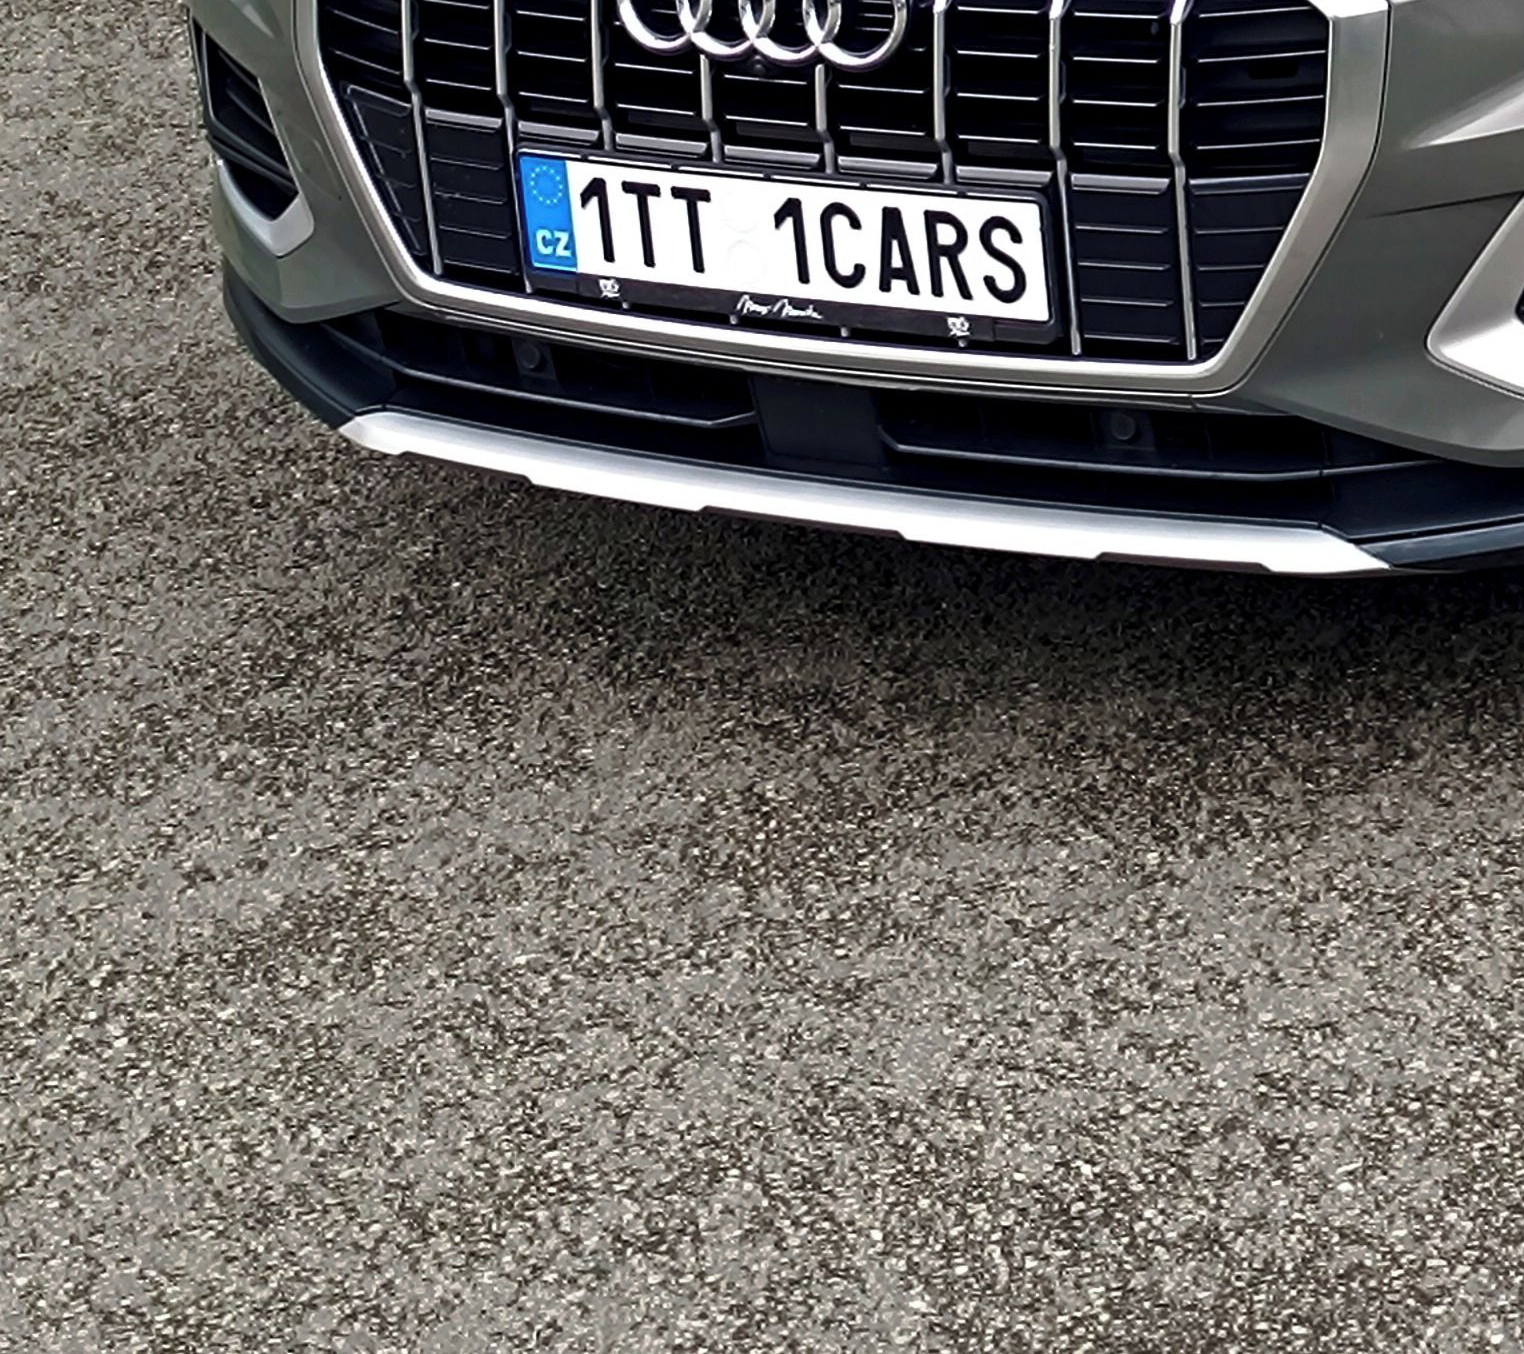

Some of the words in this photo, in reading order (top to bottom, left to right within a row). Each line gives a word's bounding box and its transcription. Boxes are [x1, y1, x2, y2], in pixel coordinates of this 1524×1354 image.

[535, 229, 572, 258] CZ
[580, 176, 711, 273] 1TT
[773, 197, 1028, 303] 1CARS
